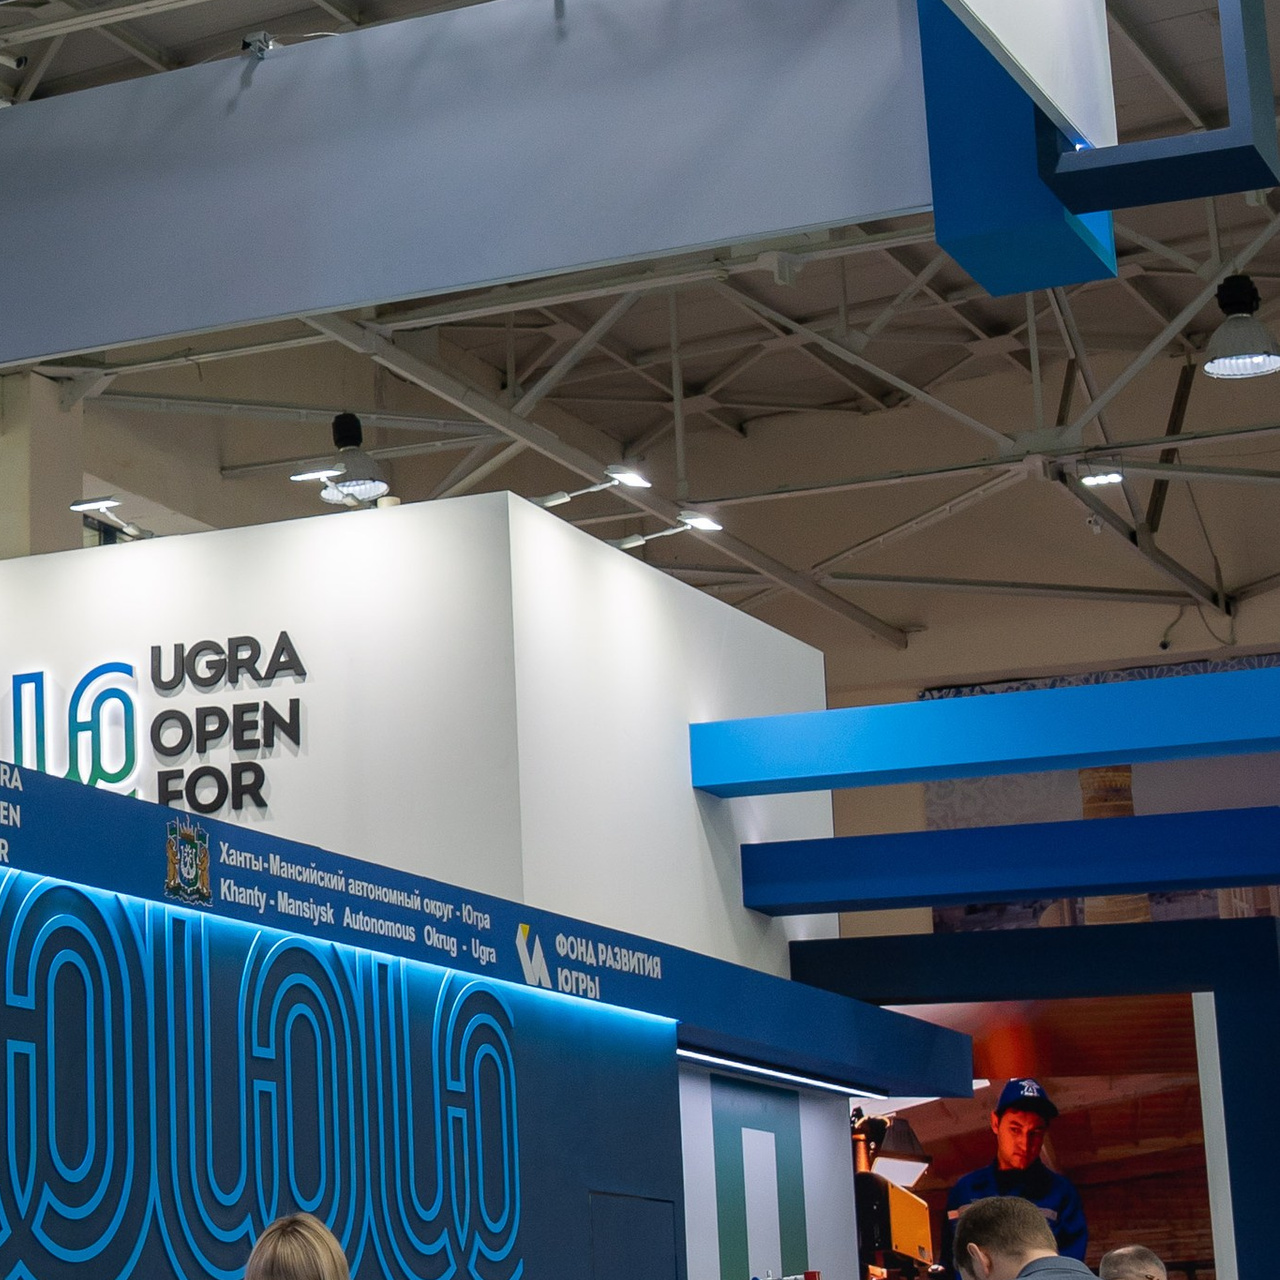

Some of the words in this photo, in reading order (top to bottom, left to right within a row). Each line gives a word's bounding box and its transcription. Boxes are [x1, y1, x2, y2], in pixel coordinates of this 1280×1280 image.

[150, 631, 307, 691] UGRA
[150, 698, 300, 757] OPEN
[157, 761, 268, 814] FOR
[220, 878, 267, 914] Khanty
[277, 890, 335, 926] Mansiysk
[343, 907, 416, 942] Autonomous
[424, 925, 457, 957] Okrug
[471, 938, 496, 966] Ugra
[348, 877, 421, 911] автономный
[423, 898, 455, 921] округ
[462, 903, 490, 930] Югра
[555, 933, 596, 967] ФОНД
[598, 942, 661, 979] РАЗВИТИЯ
[558, 967, 600, 999] ЮГРЫ
